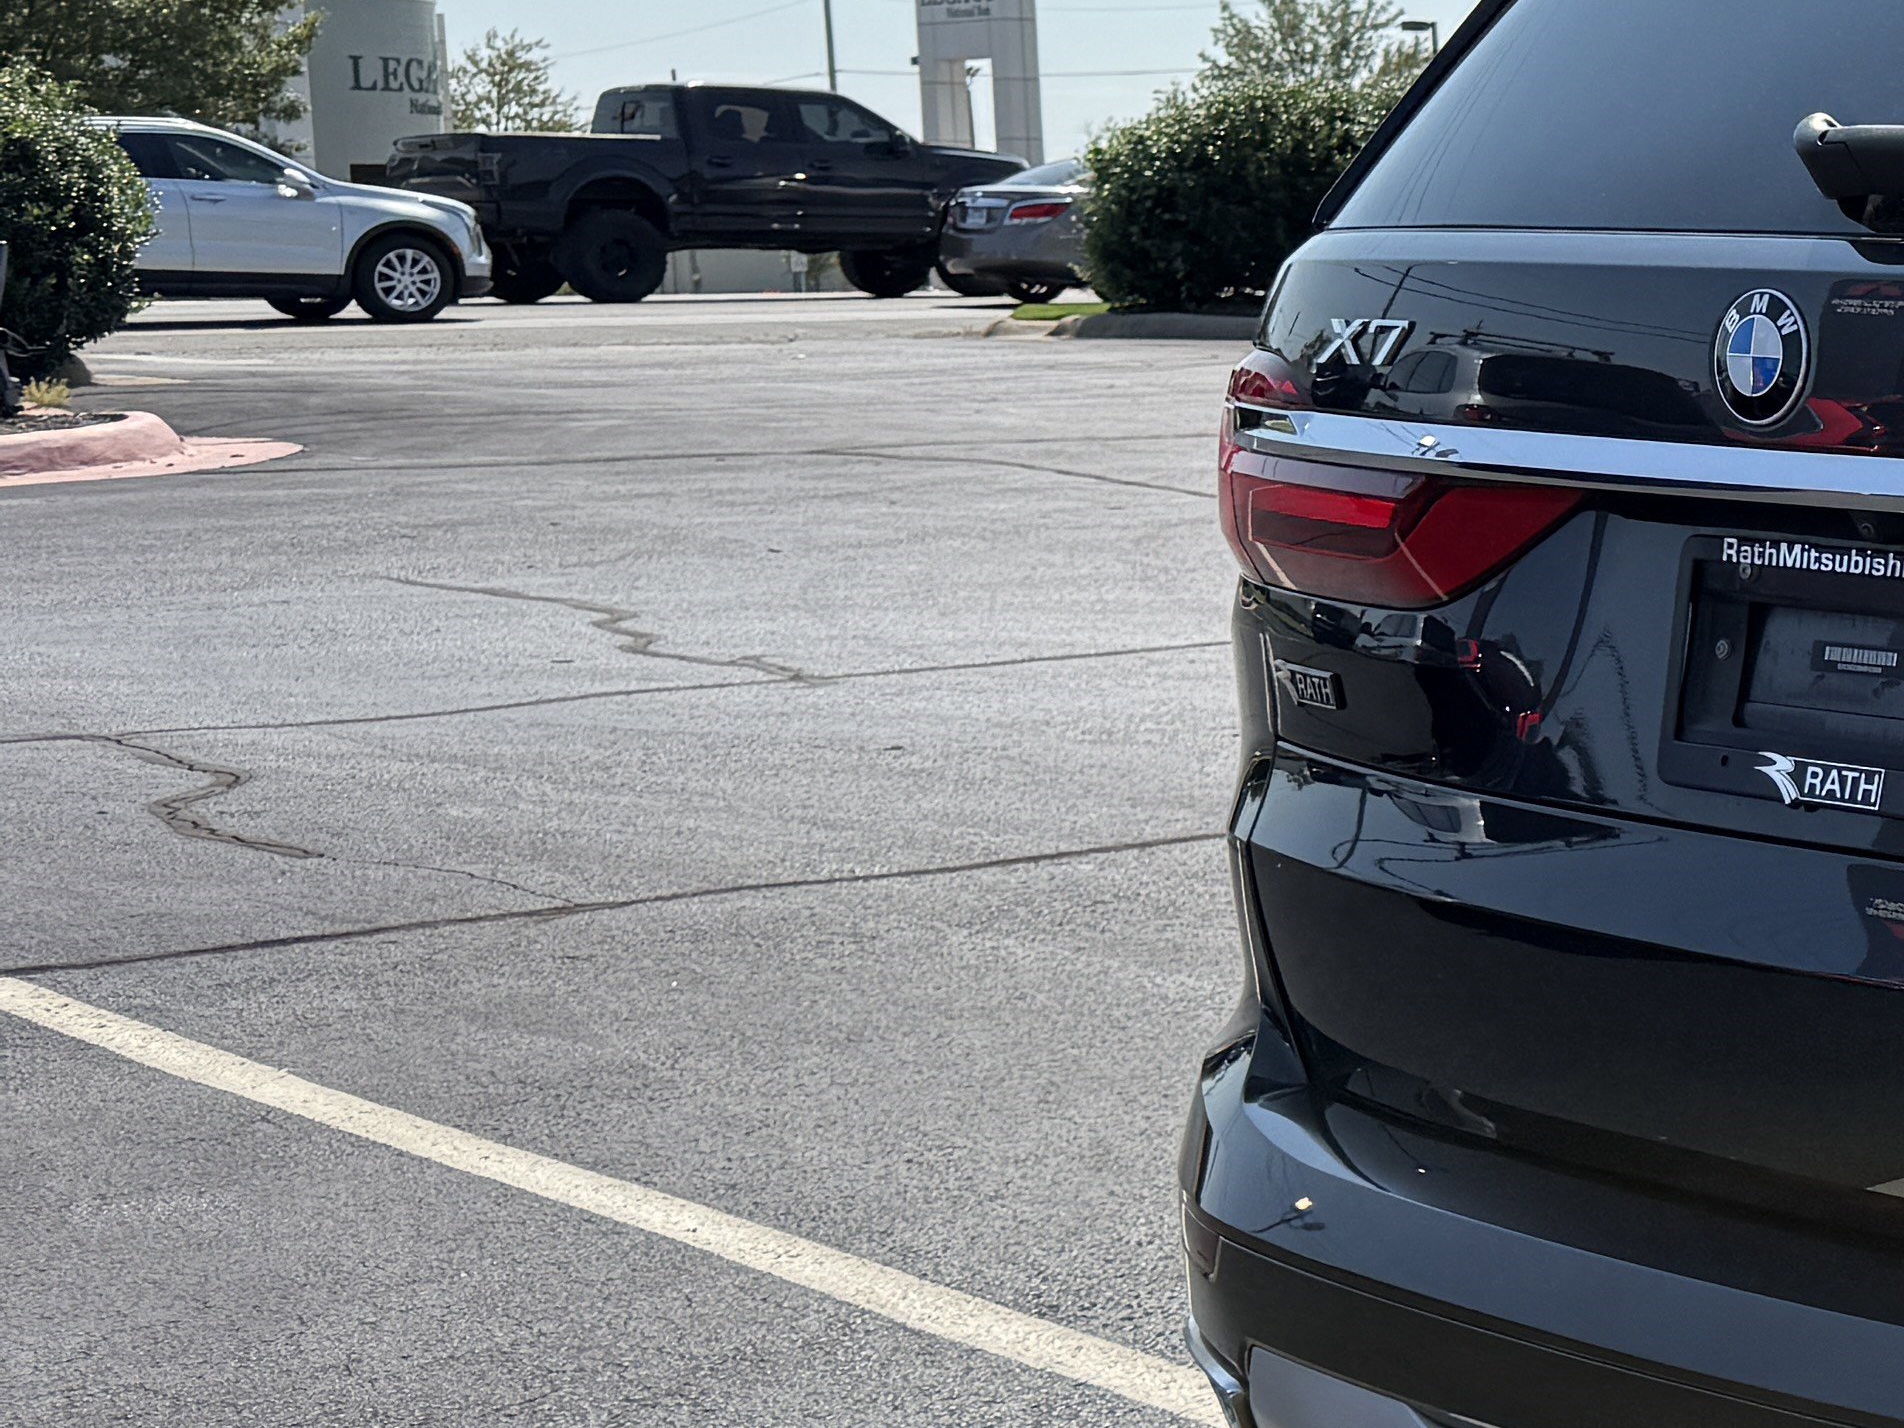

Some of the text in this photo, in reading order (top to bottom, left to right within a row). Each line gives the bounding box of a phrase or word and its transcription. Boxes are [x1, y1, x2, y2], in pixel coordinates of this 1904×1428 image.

[1725, 294, 1798, 336] BMW
[1316, 318, 1409, 366] X7
[1295, 673, 1333, 704] RATH
[1804, 766, 1879, 803] RATH
